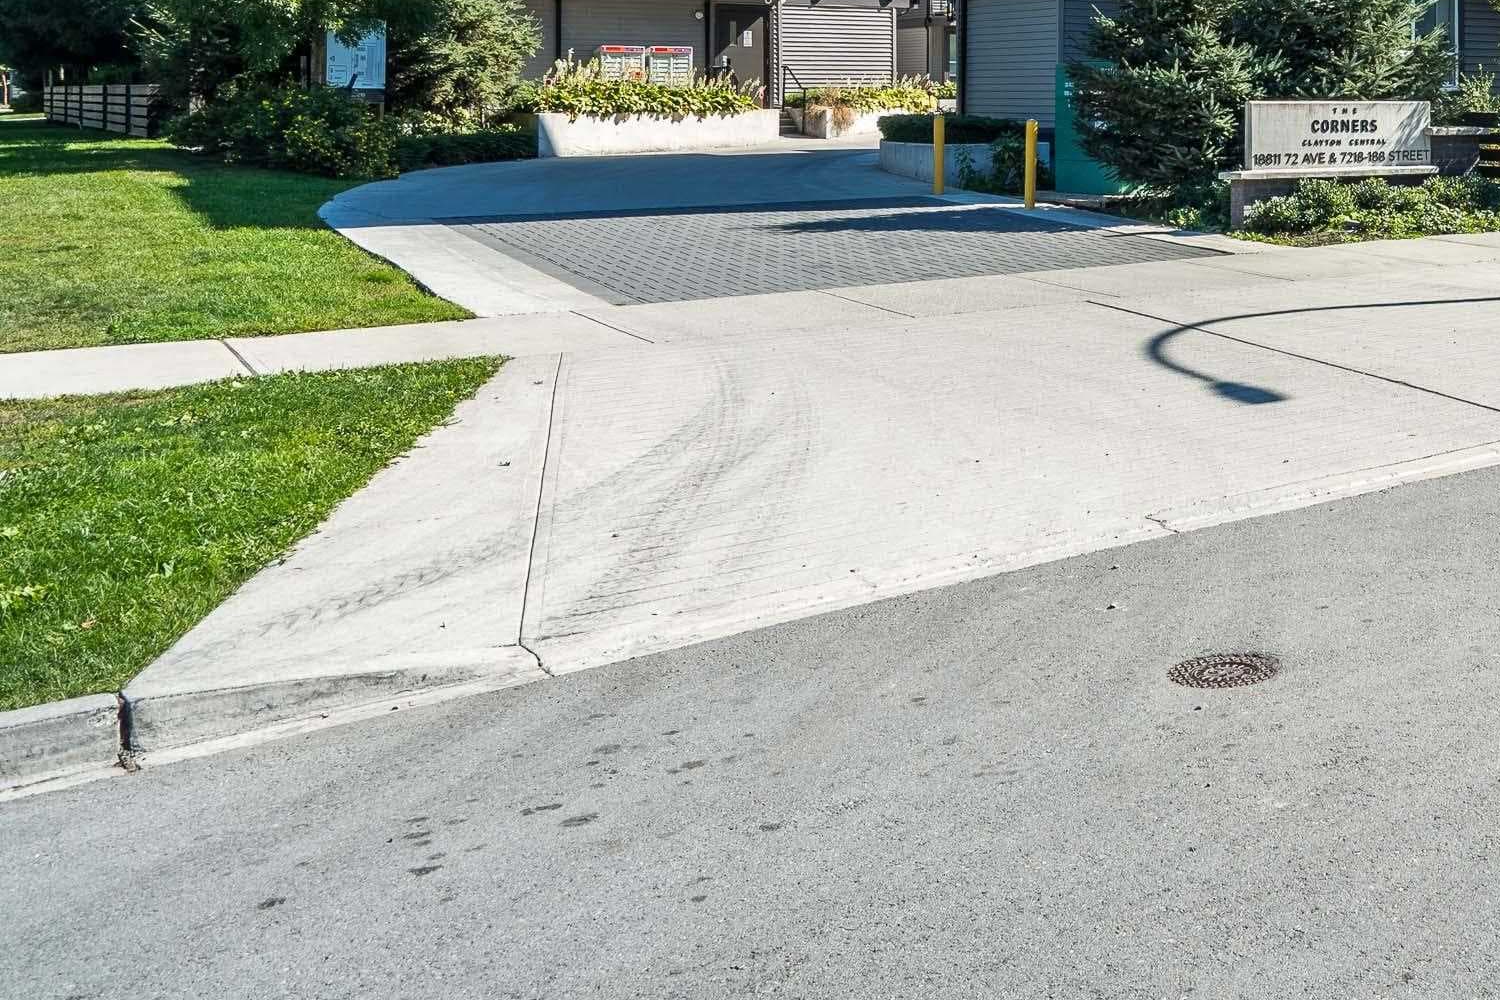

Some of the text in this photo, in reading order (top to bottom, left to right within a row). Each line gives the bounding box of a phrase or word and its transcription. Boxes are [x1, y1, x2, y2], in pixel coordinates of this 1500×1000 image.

[1332, 107, 1357, 115] THE
[1311, 119, 1378, 134] CORNERS
[1302, 138, 1386, 147] CLAYTON CENTRAL
[1253, 149, 1430, 166] 18811 72 AVE & 7218-188 STREET
